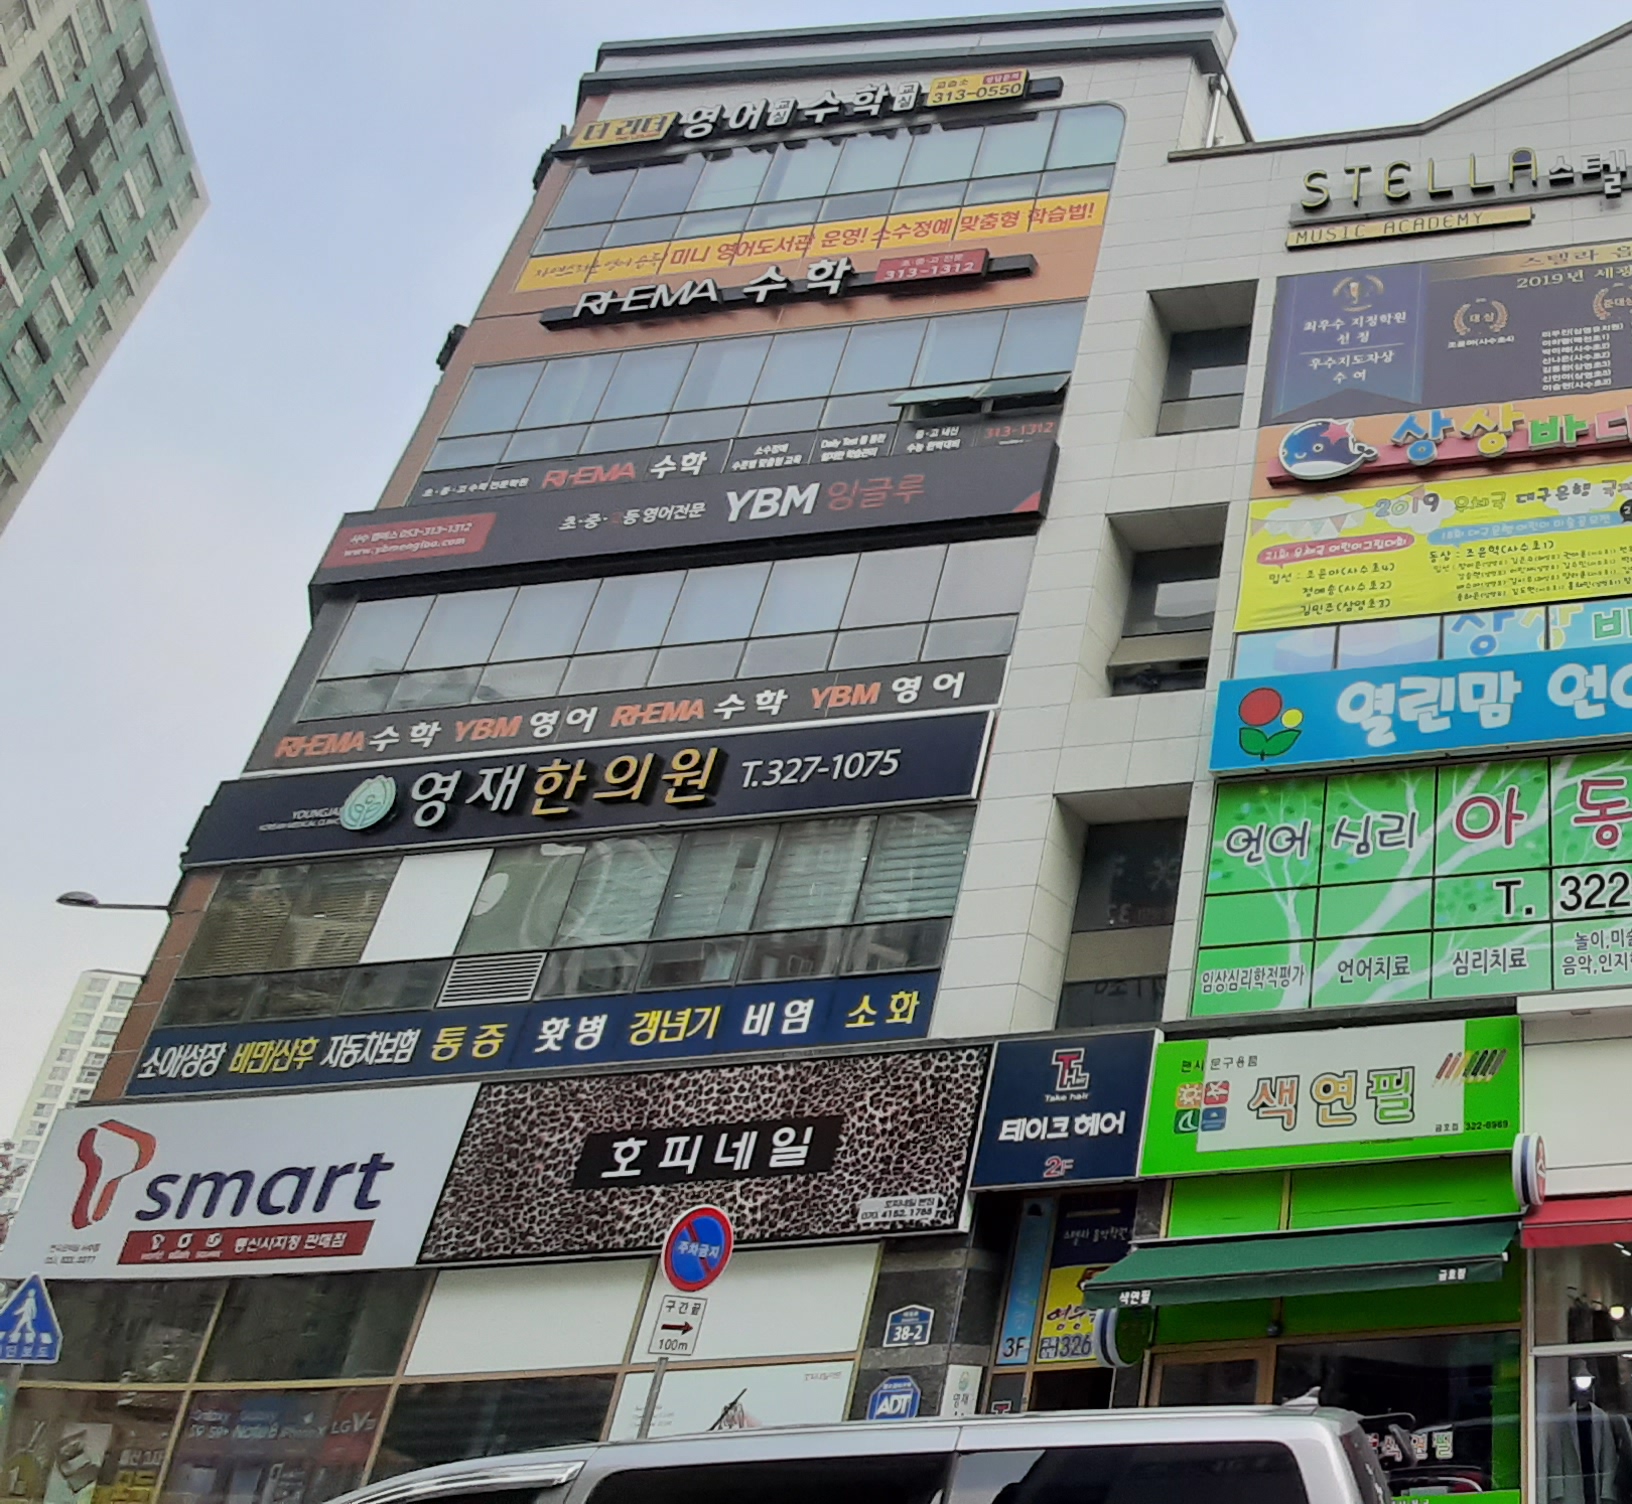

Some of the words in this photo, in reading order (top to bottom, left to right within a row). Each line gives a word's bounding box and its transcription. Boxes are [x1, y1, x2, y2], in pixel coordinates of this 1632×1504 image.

[679, 98, 767, 138] 영어
[804, 82, 889, 124] 수학
[933, 83, 1021, 105] 313-0550
[1301, 147, 1538, 208] STELLA
[670, 246, 711, 265] 미니
[821, 227, 868, 248] 운영!
[870, 217, 953, 244] 소수정예
[960, 210, 1020, 231] 맞춤형
[1029, 202, 1093, 224] 학습법!
[1296, 223, 1366, 245] MUSIC
[1382, 211, 1485, 236] ACADEMY
[743, 257, 851, 304] 수학
[884, 262, 974, 280] 313-1312
[1516, 268, 1585, 289] 2019년
[1304, 318, 1345, 332] 최우수
[1351, 311, 1406, 327] 지정학원
[1308, 350, 1394, 369] 우수지도자상
[650, 451, 707, 480] 수학
[726, 482, 820, 523] YBM
[827, 474, 925, 512] 잉글루
[1375, 493, 1440, 518] 2019
[1516, 482, 1591, 504] 대구은행
[369, 721, 442, 752] 수학
[455, 715, 523, 743] YBM
[529, 706, 598, 738] 영어
[713, 688, 788, 720] 수학
[811, 682, 881, 709] YBM
[891, 672, 965, 704] 영어
[1336, 671, 1523, 748] 열린맘
[411, 747, 721, 829] 영재한의원
[742, 749, 902, 790] T.327-1075
[1226, 820, 1309, 866] 언어
[1331, 811, 1417, 859] 심리
[1336, 955, 1412, 985] 언어치료
[1452, 947, 1529, 977] 심리치료
[320, 1028, 421, 1070] 자동차보험
[430, 1023, 508, 1062] 통증
[535, 1014, 607, 1053] 홧병
[629, 1005, 721, 1046] 갱년기
[742, 998, 813, 1037] 비염
[845, 990, 920, 1029] 소화
[1247, 1066, 1417, 1132] 색연필
[998, 1116, 1070, 1142] 테이크
[1074, 1110, 1126, 1137] 헤어
[601, 1126, 814, 1179] 호피네일
[1043, 1155, 1075, 1178] 2F
[135, 1152, 395, 1223] smart
[678, 1241, 721, 1260] 주차금지
[1119, 1289, 1151, 1305] 색연필
[658, 1337, 689, 1352] 100m
[892, 1324, 923, 1342] 38-2
[1002, 1337, 1027, 1358] 3F
[876, 1394, 913, 1416] ADT
